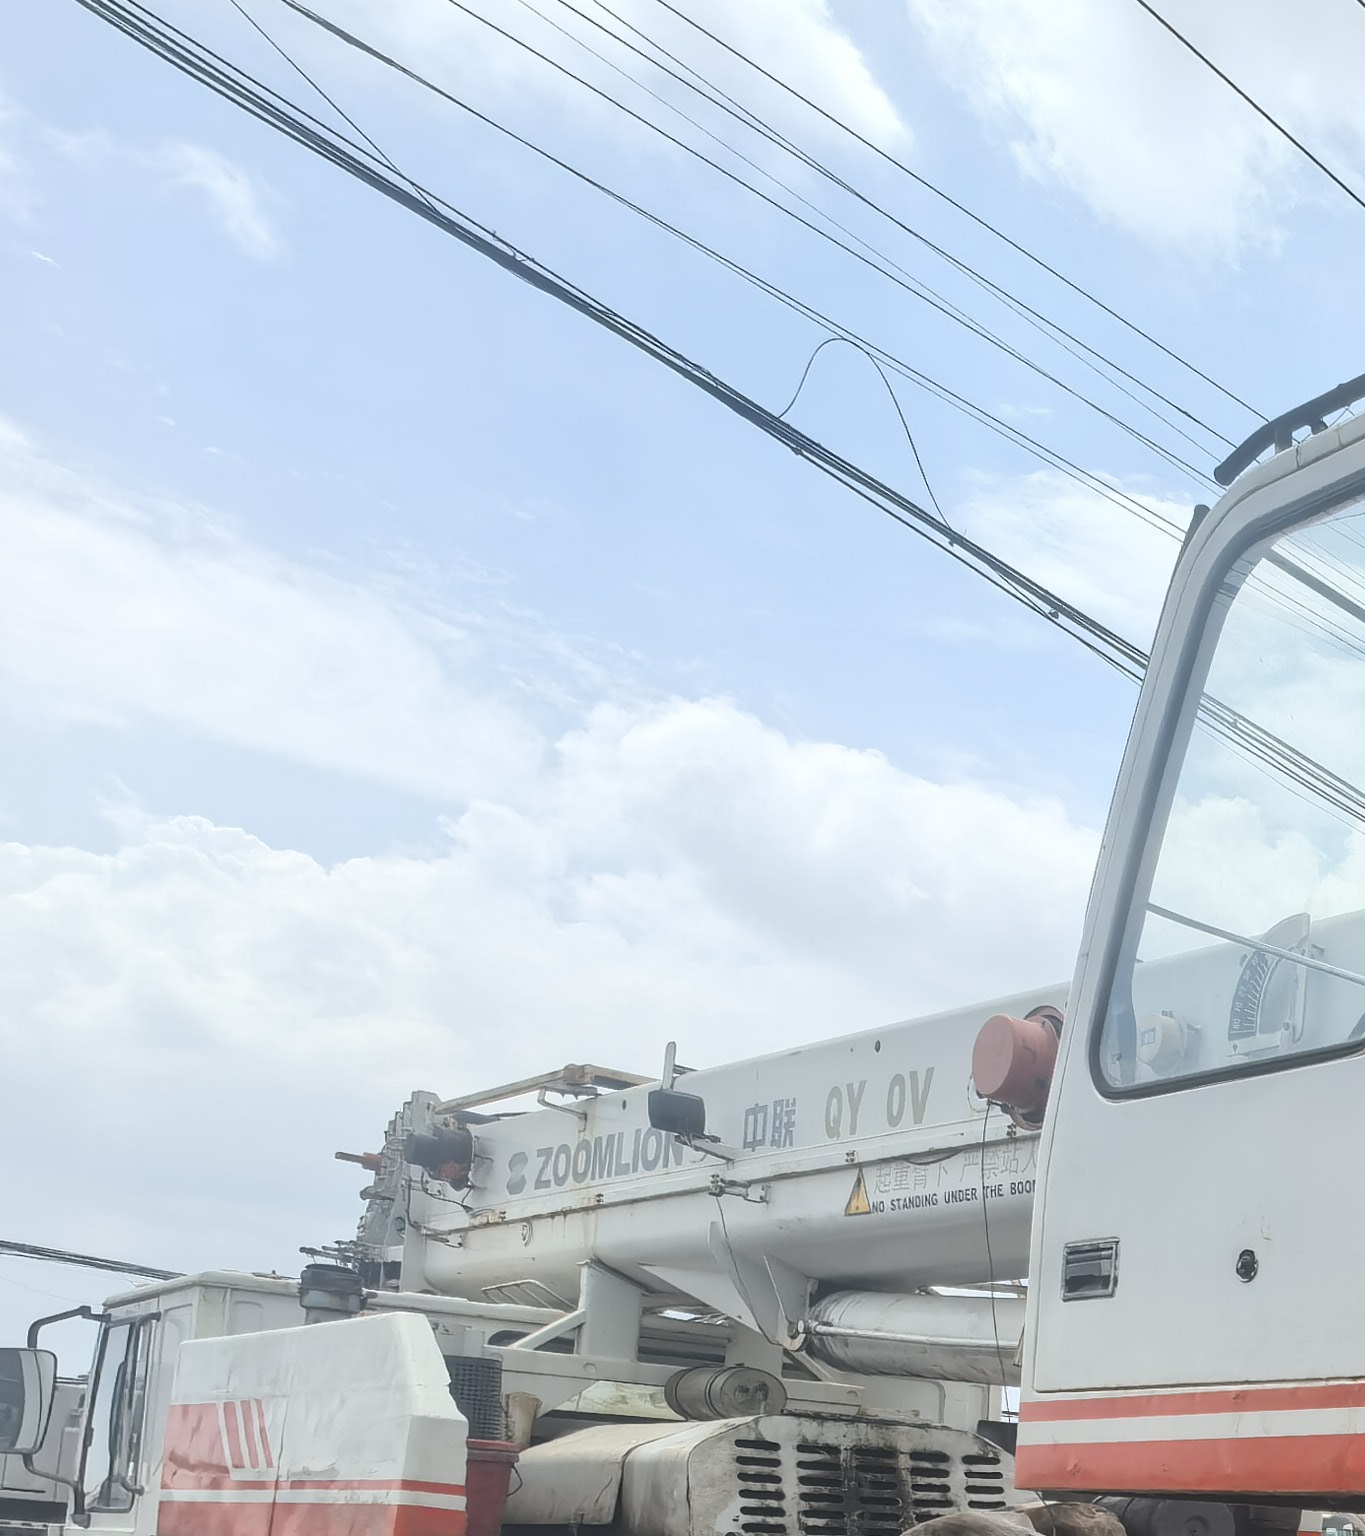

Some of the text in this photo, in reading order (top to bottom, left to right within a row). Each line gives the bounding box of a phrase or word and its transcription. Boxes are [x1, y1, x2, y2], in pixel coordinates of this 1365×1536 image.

[825, 1080, 867, 1140] QY
[533, 1126, 684, 1191] ZOOMLION
[871, 1200, 885, 1214] NO
[890, 1193, 938, 1212] STANDING
[944, 1187, 978, 1205] UNDER
[983, 1184, 1004, 1199] THE
